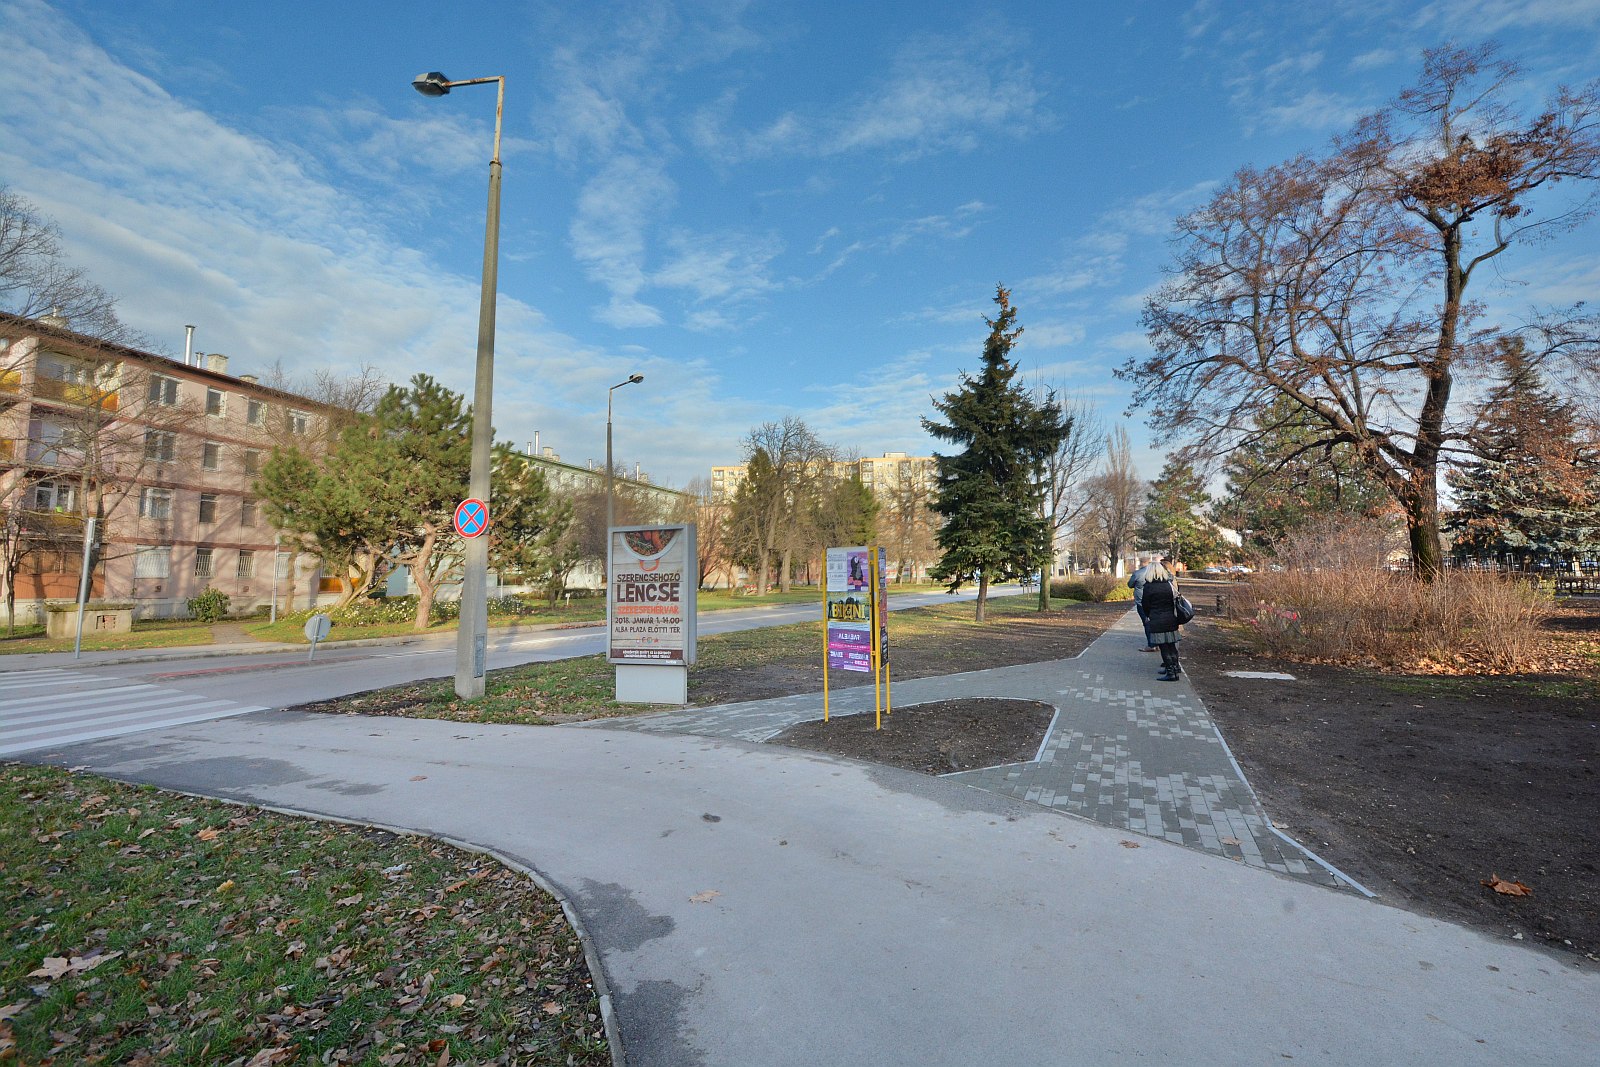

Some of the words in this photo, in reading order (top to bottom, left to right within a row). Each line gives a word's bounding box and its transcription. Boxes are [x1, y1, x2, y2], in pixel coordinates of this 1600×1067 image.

[617, 570, 680, 582] SZERENCSEHOZÓ
[617, 583, 679, 602] LENCSE
[633, 615, 654, 624] JANUÁR
[670, 625, 680, 633] TÉR
